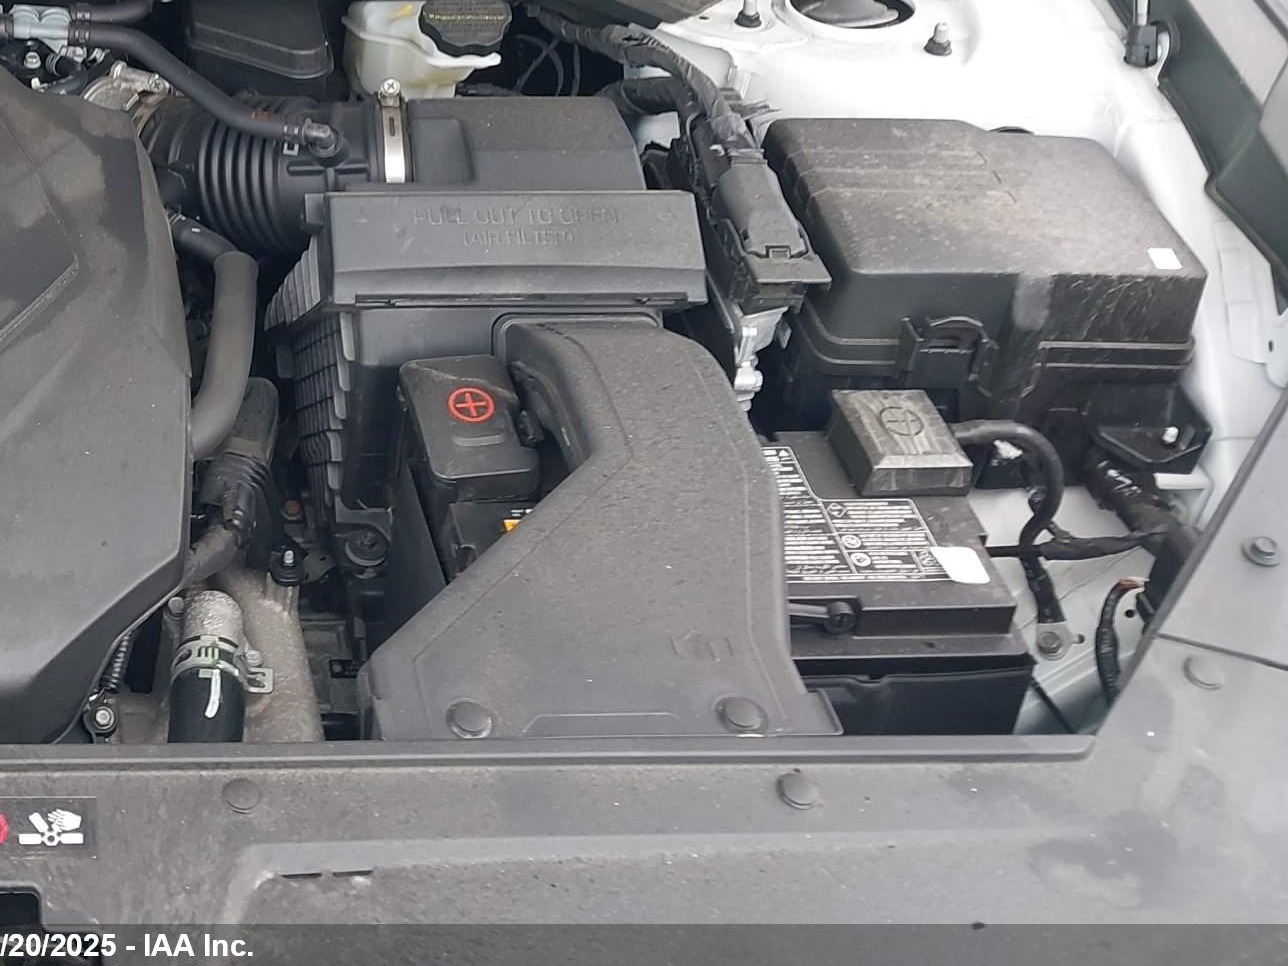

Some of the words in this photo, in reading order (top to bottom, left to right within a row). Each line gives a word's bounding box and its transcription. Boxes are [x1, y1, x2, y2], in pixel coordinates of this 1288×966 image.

[413, 205, 469, 226] PULL
[475, 205, 520, 225] OUT
[526, 205, 553, 225] TO
[559, 205, 620, 225] OPEN
